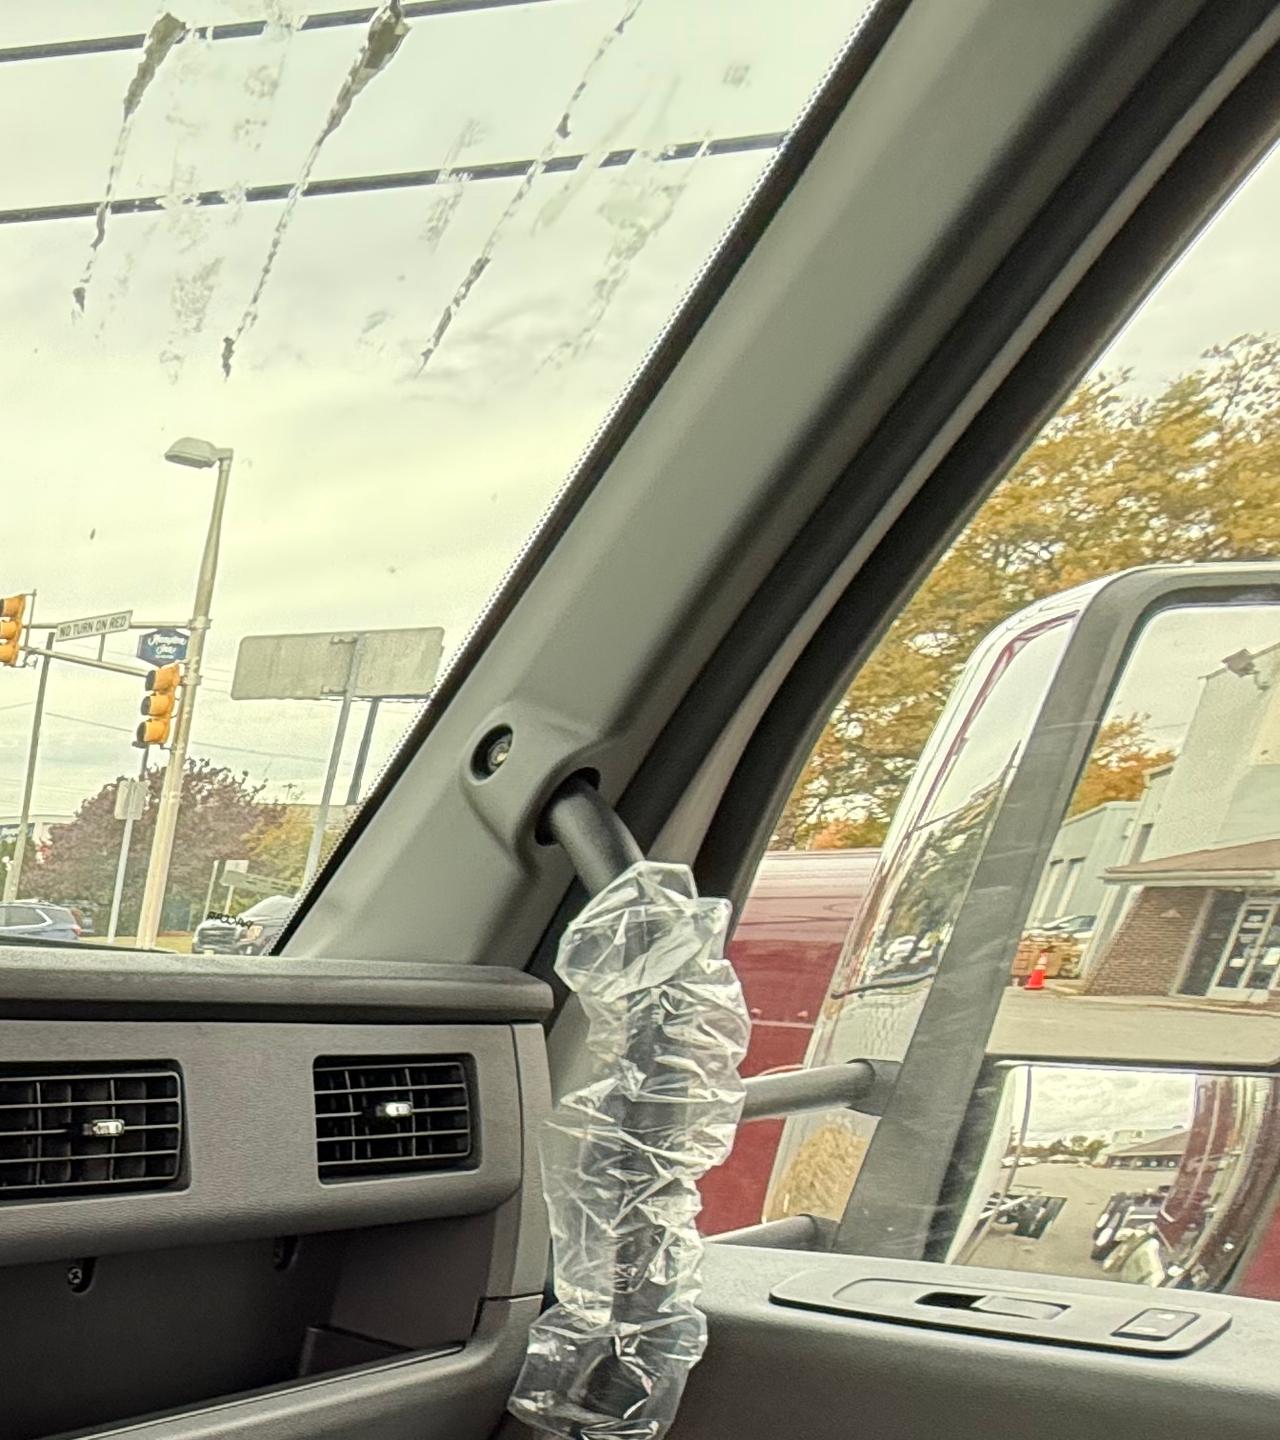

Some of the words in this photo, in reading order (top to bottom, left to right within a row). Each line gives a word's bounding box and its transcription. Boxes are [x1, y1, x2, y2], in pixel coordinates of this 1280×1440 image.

[59, 626, 72, 638] NO
[72, 621, 93, 636] TURN
[96, 619, 108, 632] ON
[109, 615, 127, 628] RED
